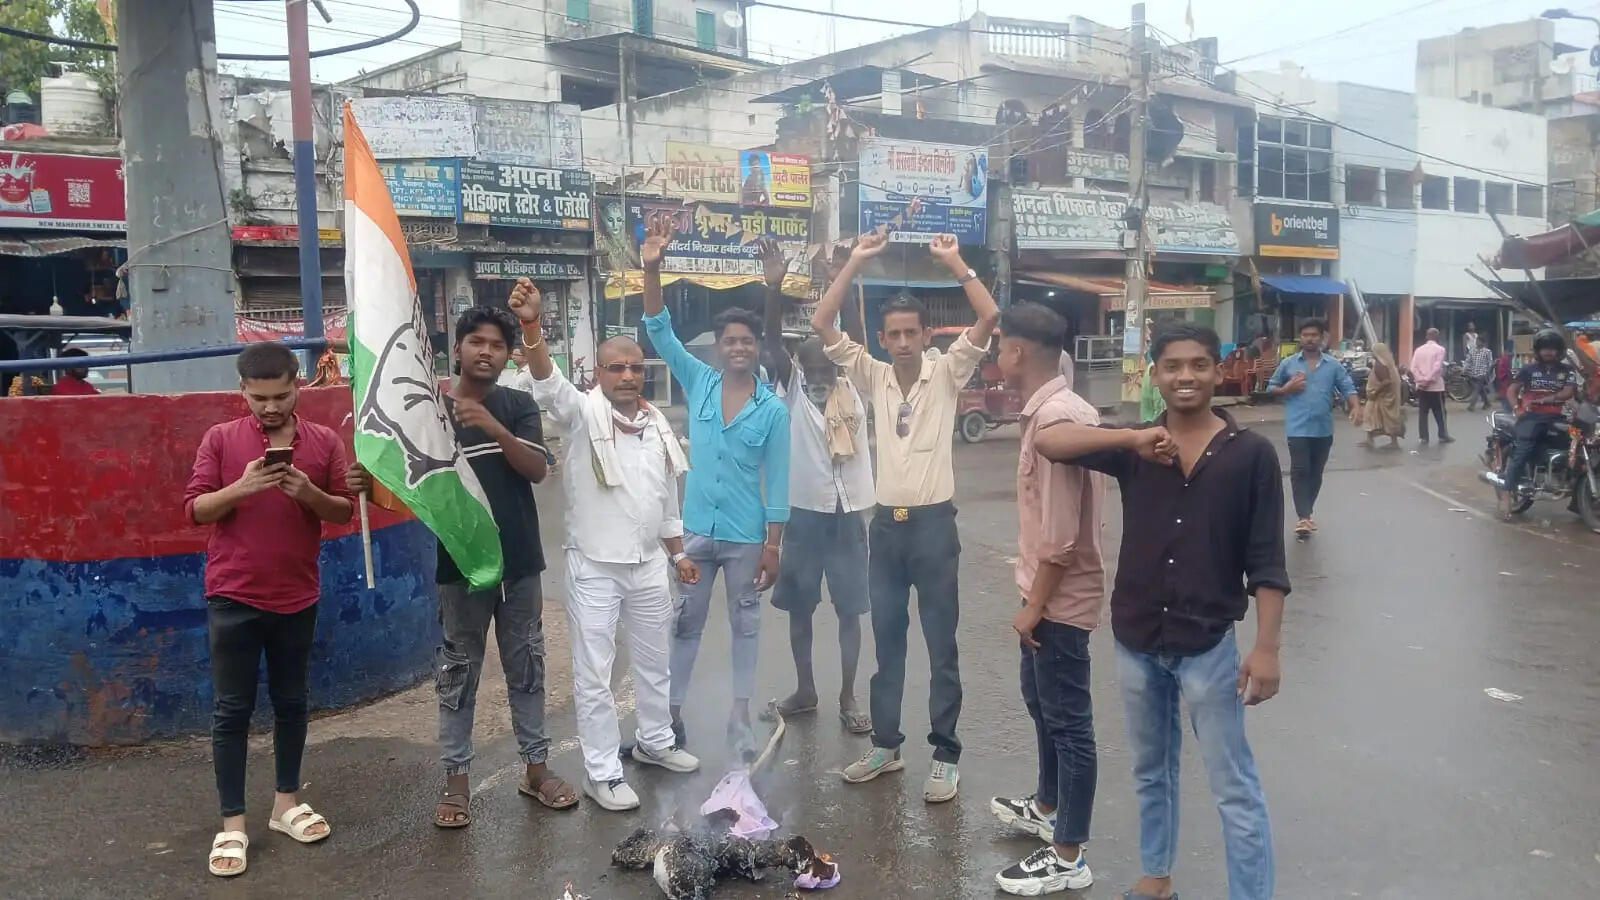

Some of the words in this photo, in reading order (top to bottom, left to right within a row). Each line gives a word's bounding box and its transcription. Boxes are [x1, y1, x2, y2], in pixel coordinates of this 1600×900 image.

[498, 165, 562, 190] अपना
[461, 183, 510, 213] मेडिकल
[514, 188, 541, 215] स्टोर
[543, 199, 552, 212] &
[554, 191, 590, 219] एजेंसी
[475, 262, 501, 273] अपना
[503, 259, 536, 274] मेडिकल
[540, 261, 556, 275] स्टोर
